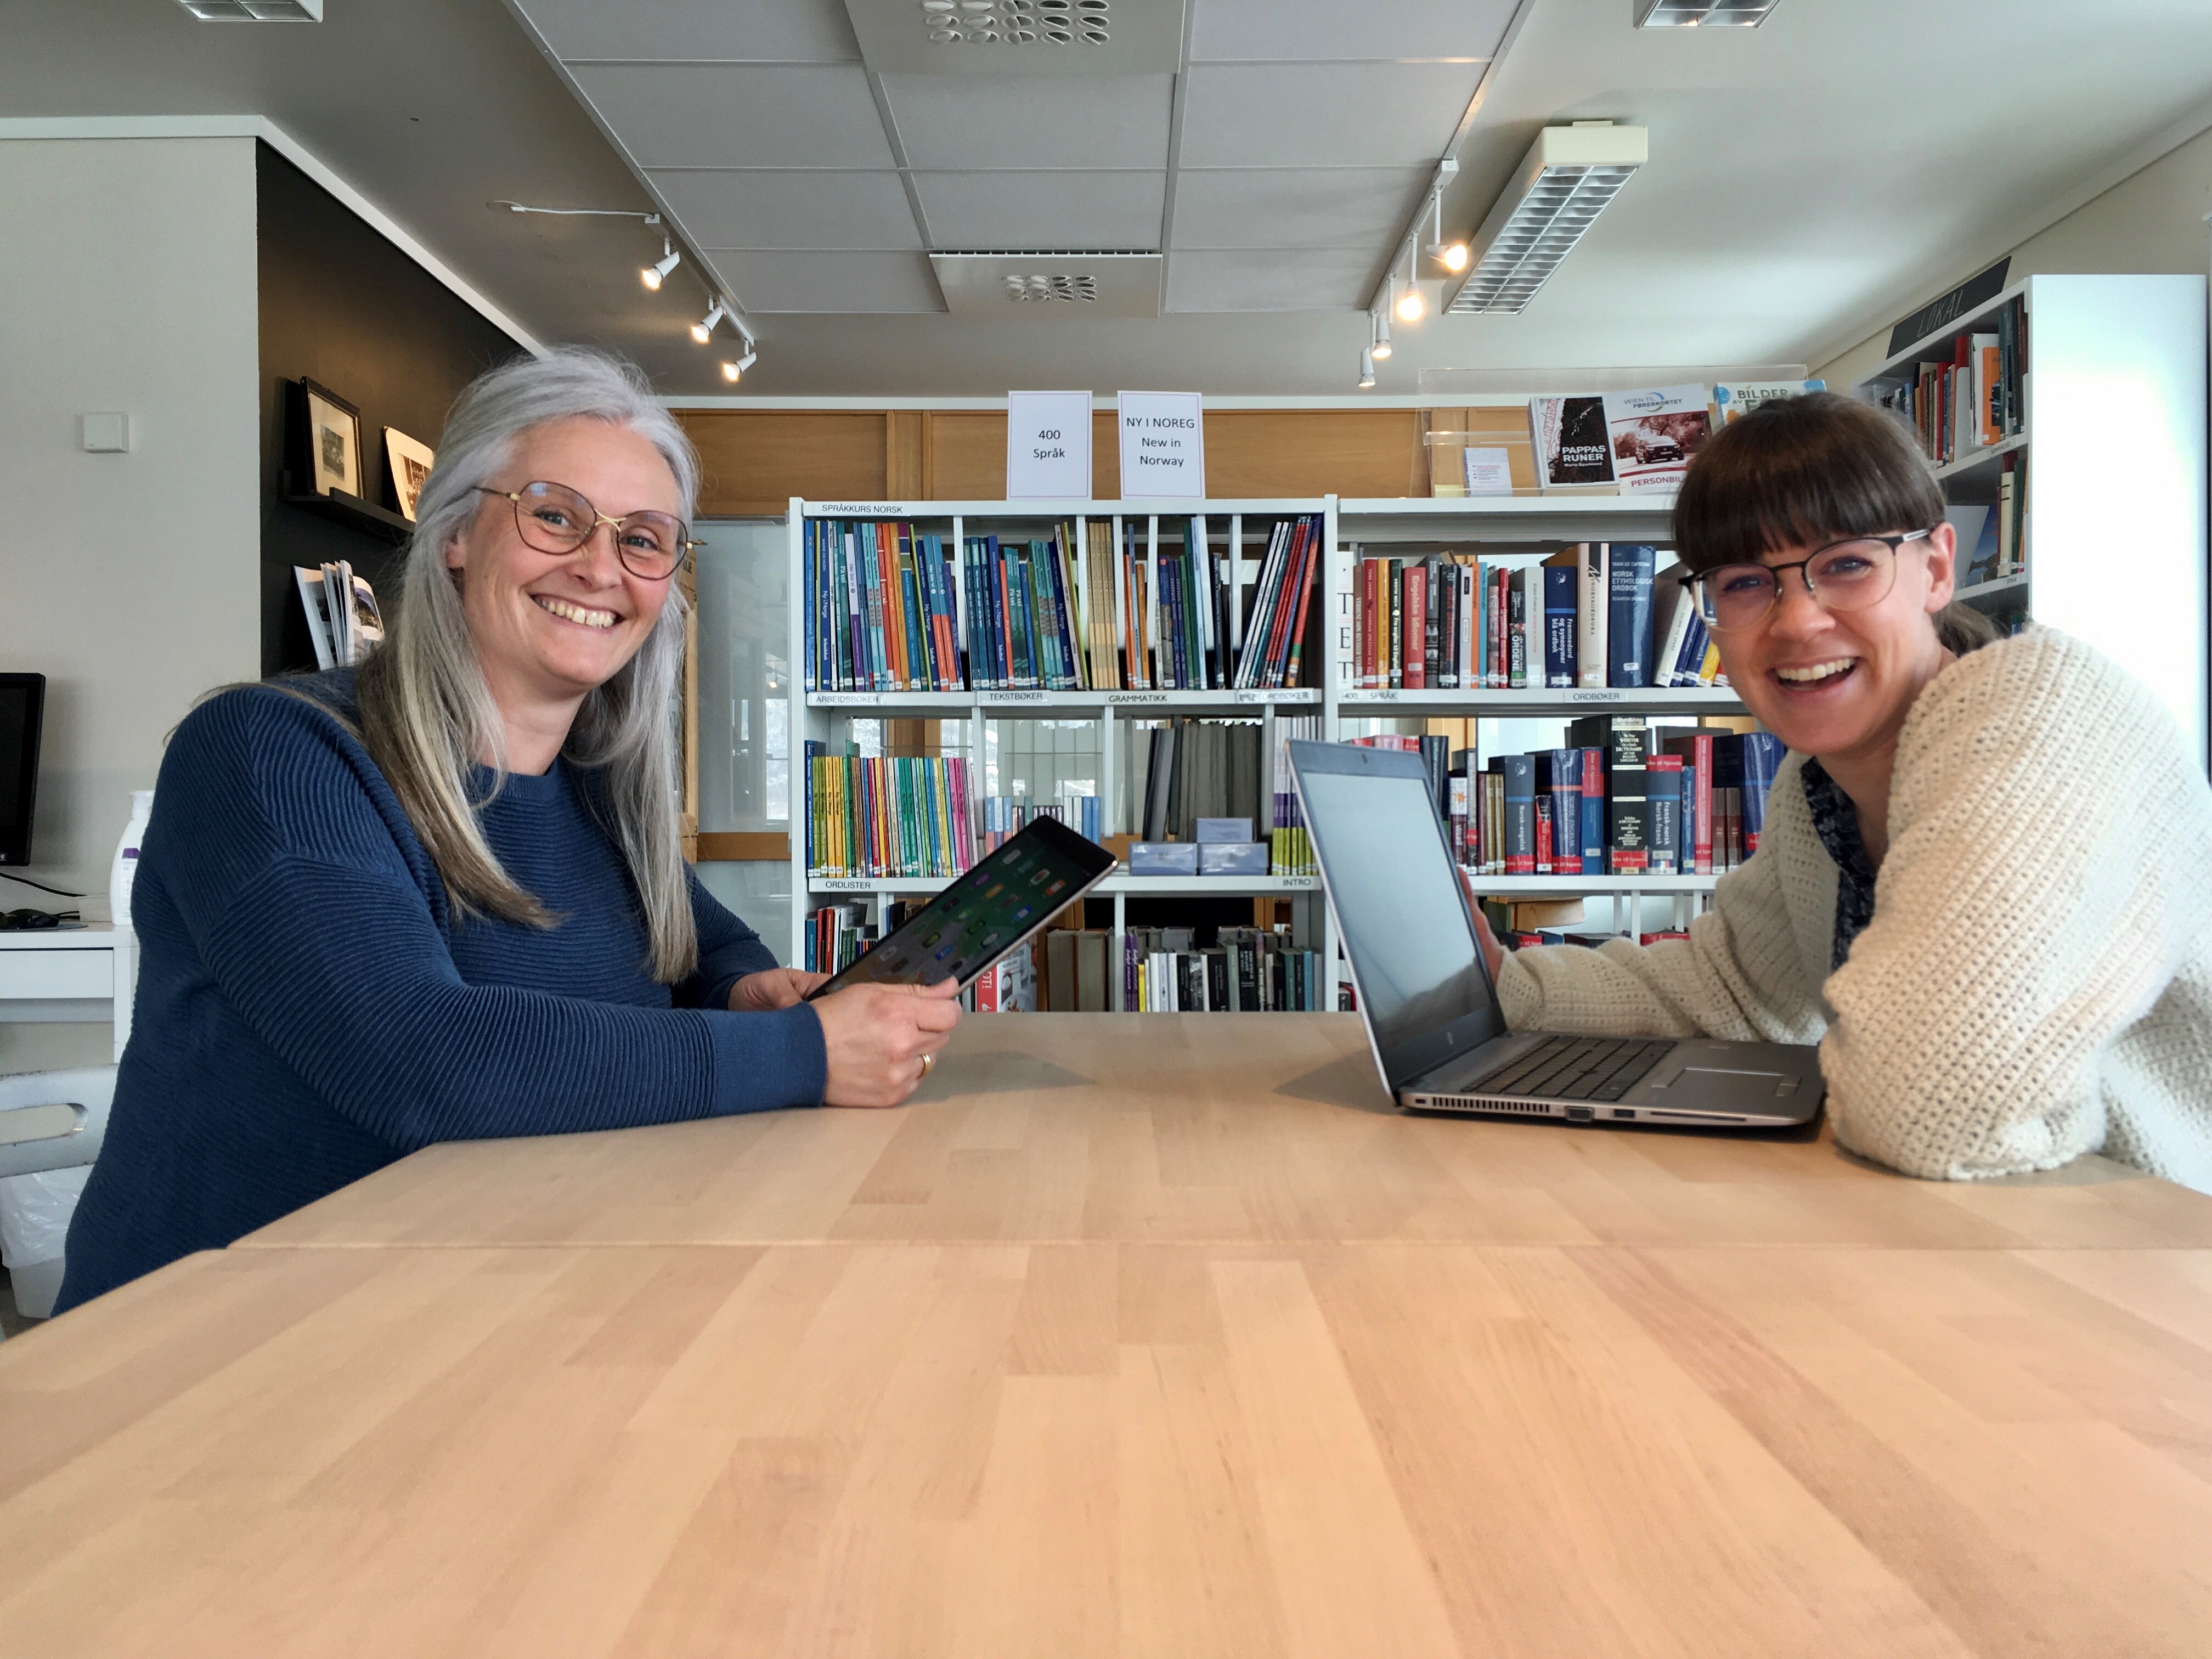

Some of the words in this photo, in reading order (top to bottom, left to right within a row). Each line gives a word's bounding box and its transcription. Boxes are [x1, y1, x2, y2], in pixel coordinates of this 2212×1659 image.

[1917, 289, 1963, 338] LOKAL
[1737, 389, 1788, 399] BILDER
[1633, 399, 1683, 409] FØRERKORTET
[1127, 417, 1142, 427] NY
[1146, 417, 1149, 427] I
[1153, 418, 1194, 428] NOREG
[1039, 430, 1060, 439] 400
[1142, 437, 1167, 447] New
[1171, 438, 1181, 447] in
[1034, 448, 1065, 460] Språk
[1561, 444, 1606, 455] PAPPAS
[1140, 455, 1184, 467] Norway
[1563, 453, 1604, 462] RUNER
[821, 501, 871, 514] SPRÅKKURS
[874, 503, 902, 514] NORSK
[1411, 575, 1420, 614] Engelske
[1559, 618, 1565, 627] og
[1511, 635, 1520, 672] ORDENE
[816, 695, 879, 703] ARBEIDSBØKER
[989, 692, 1043, 701] TEKSTBØKER
[1108, 694, 1168, 703] GRAMMATIKK
[1369, 690, 1397, 699] SPRÅK
[1573, 692, 1621, 701] ORDBØKER
[825, 881, 871, 889] ORDLISTER
[1282, 878, 1312, 887] INTRO
